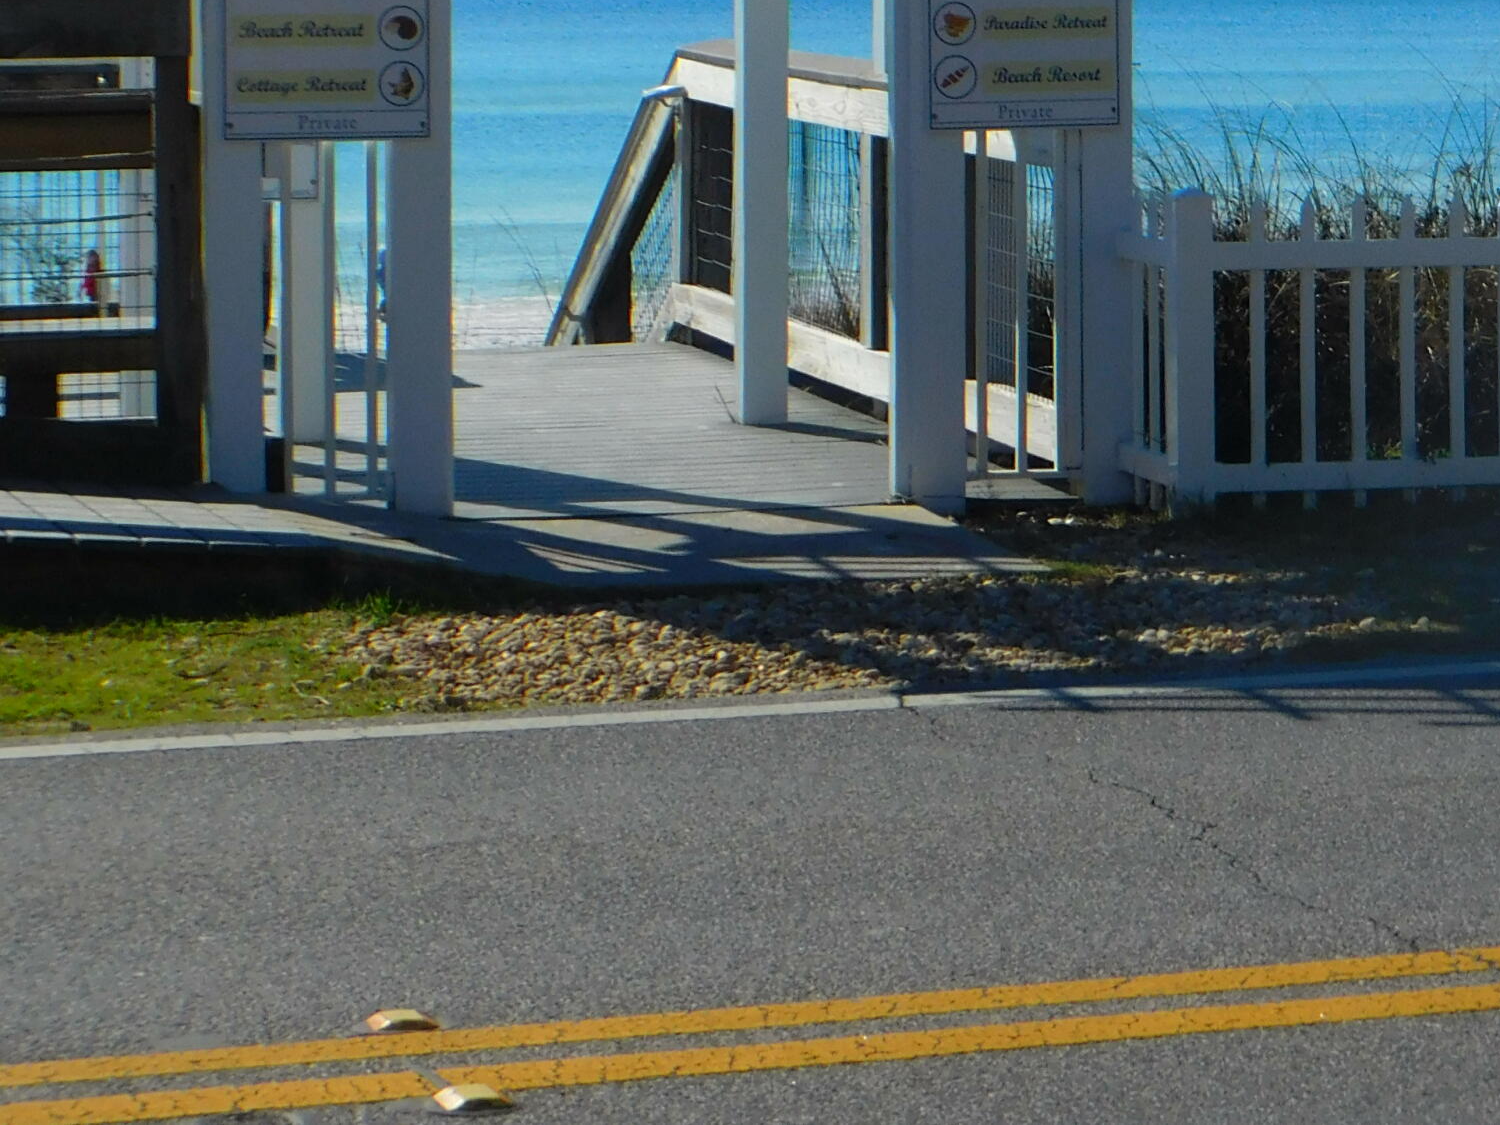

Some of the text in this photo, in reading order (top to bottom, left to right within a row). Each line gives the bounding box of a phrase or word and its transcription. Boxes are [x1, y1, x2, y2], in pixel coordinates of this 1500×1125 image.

[238, 20, 365, 39] Beach Retreat
[983, 13, 1108, 32] Paradise Retreat
[992, 65, 1101, 85] Beach Resort
[236, 75, 367, 97] Cottage Retreat
[997, 104, 1054, 120] Private
[298, 114, 358, 131] Private
